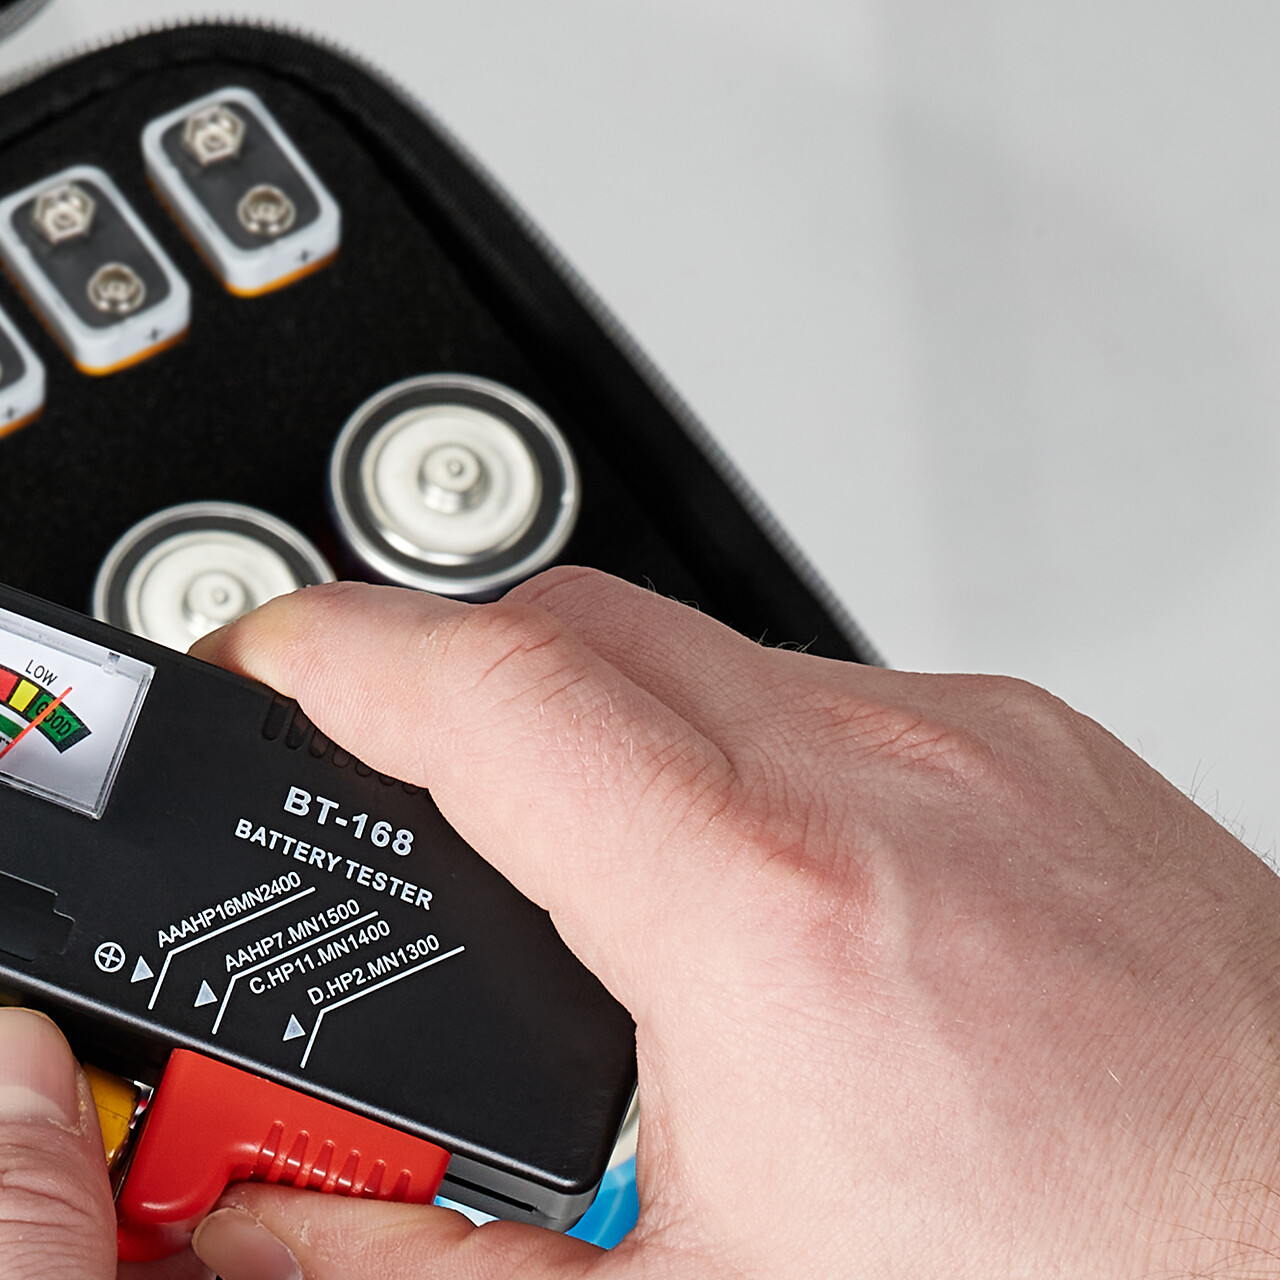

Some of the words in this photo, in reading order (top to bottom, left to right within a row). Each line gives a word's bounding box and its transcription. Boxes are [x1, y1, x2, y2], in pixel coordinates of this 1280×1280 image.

[25, 659, 58, 686] LOW
[283, 785, 415, 856] BT-168
[234, 818, 342, 873] BATTERY
[345, 859, 434, 911] TESTER
[157, 871, 302, 948] AAAHP16MN2400
[224, 898, 361, 973] AAHP7.MN1500
[249, 920, 391, 996] C.HP11.MN1400
[307, 934, 440, 1006] D.HP2.MN1300
